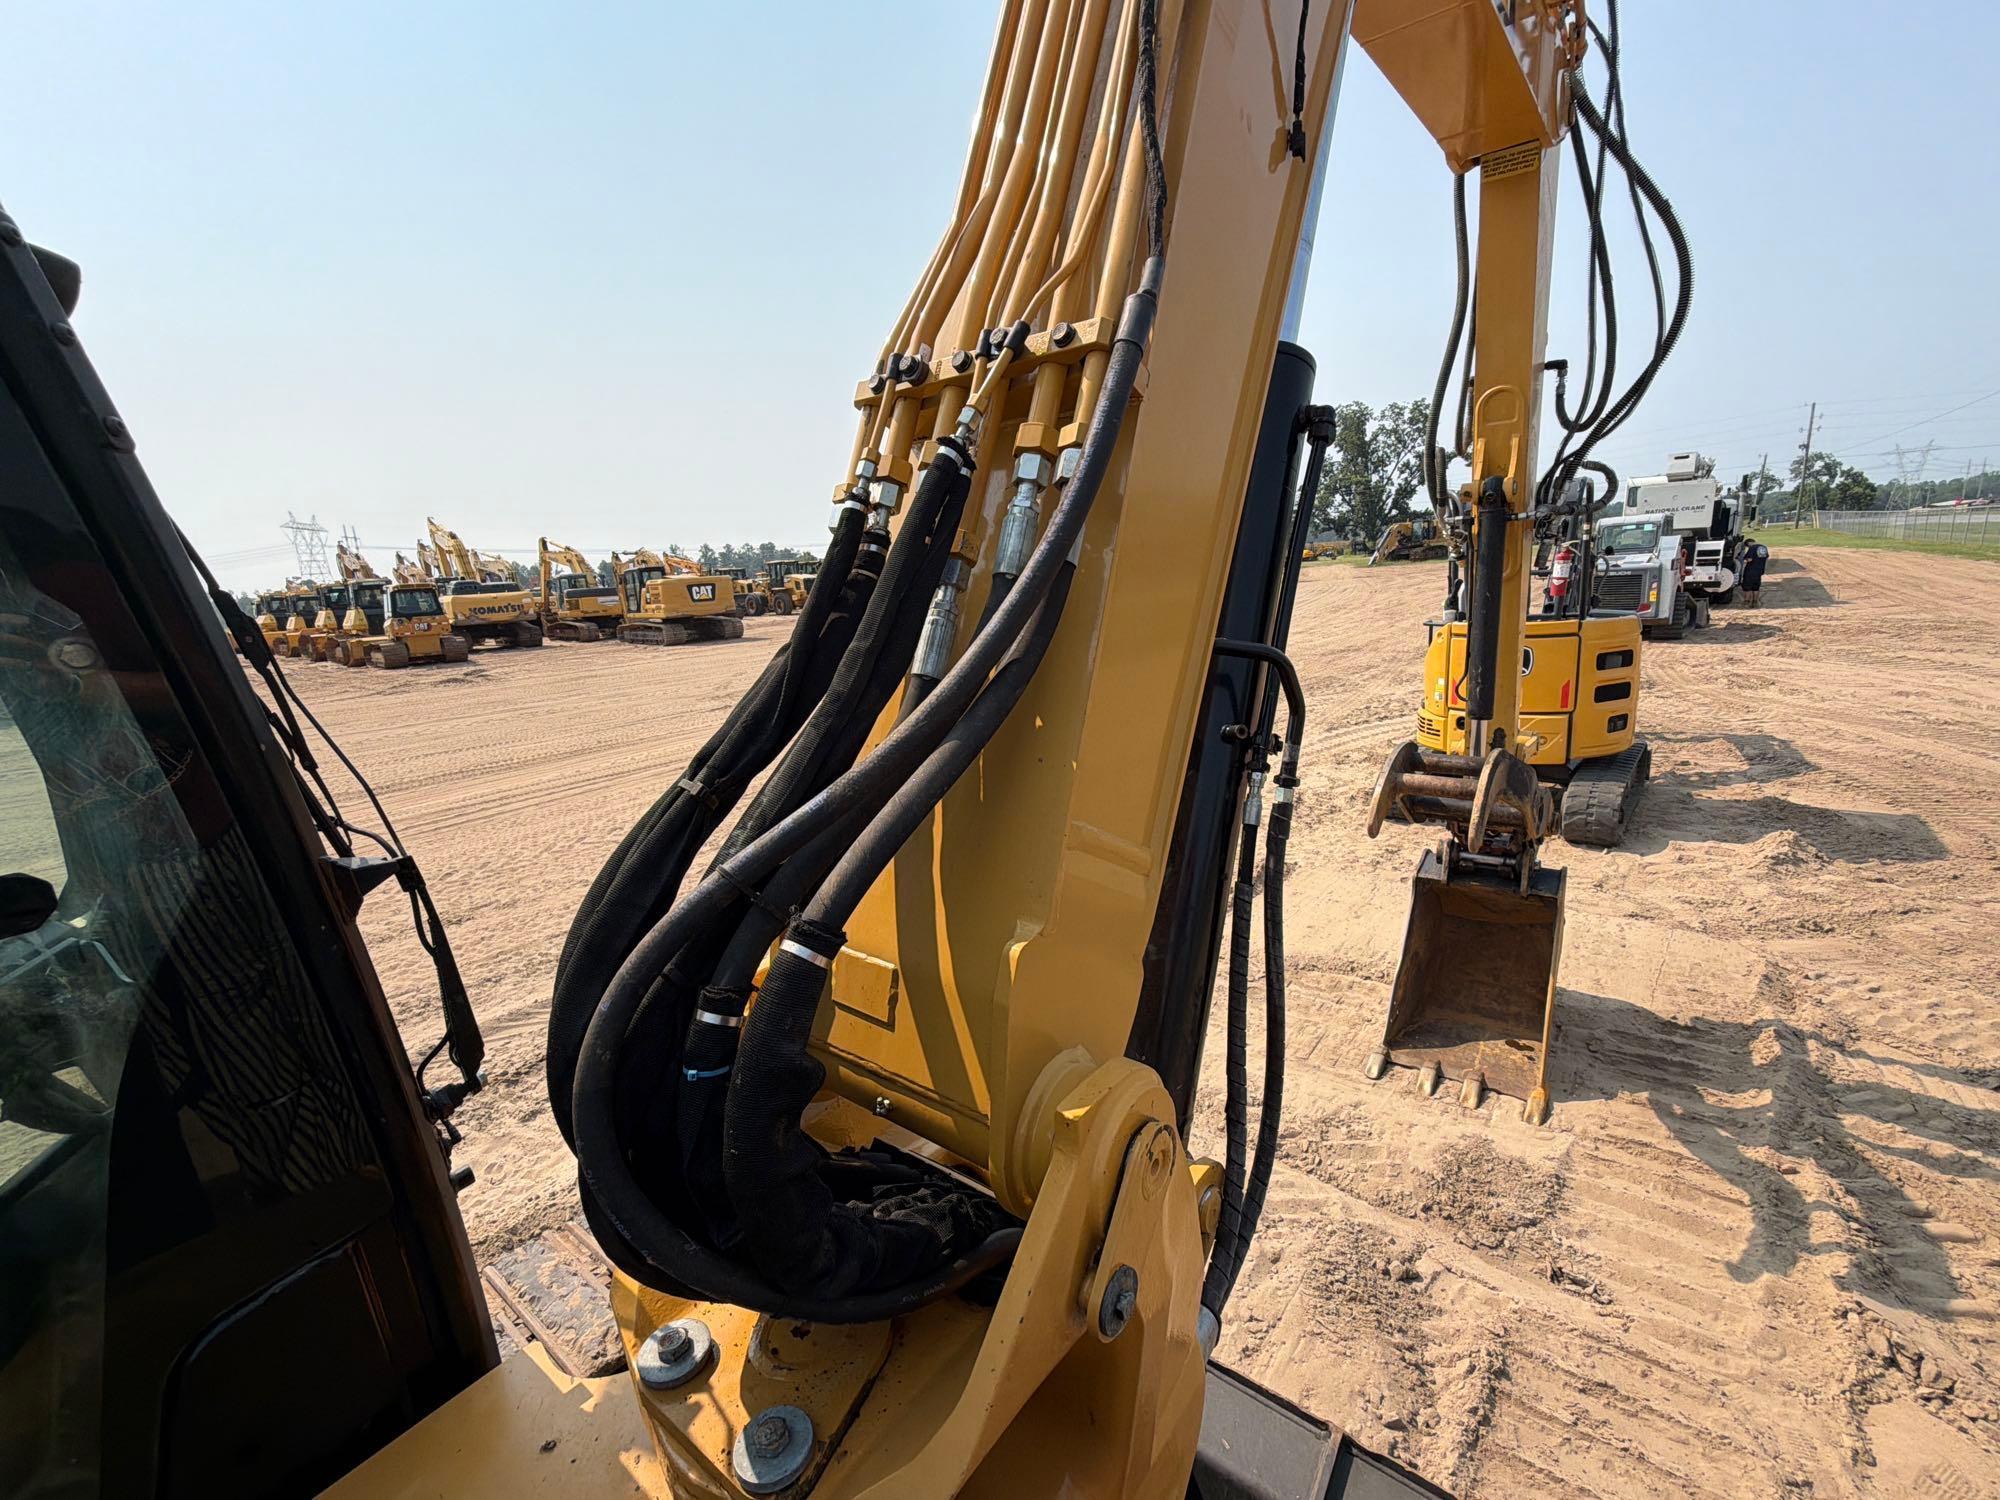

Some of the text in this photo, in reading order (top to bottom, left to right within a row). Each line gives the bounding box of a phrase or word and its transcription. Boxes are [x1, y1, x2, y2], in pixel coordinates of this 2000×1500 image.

[1645, 504, 1706, 514] NATIONAL CRANE
[691, 585, 713, 600] CAT
[469, 603, 525, 615] KOMATSU
[414, 622, 429, 632] CAT
